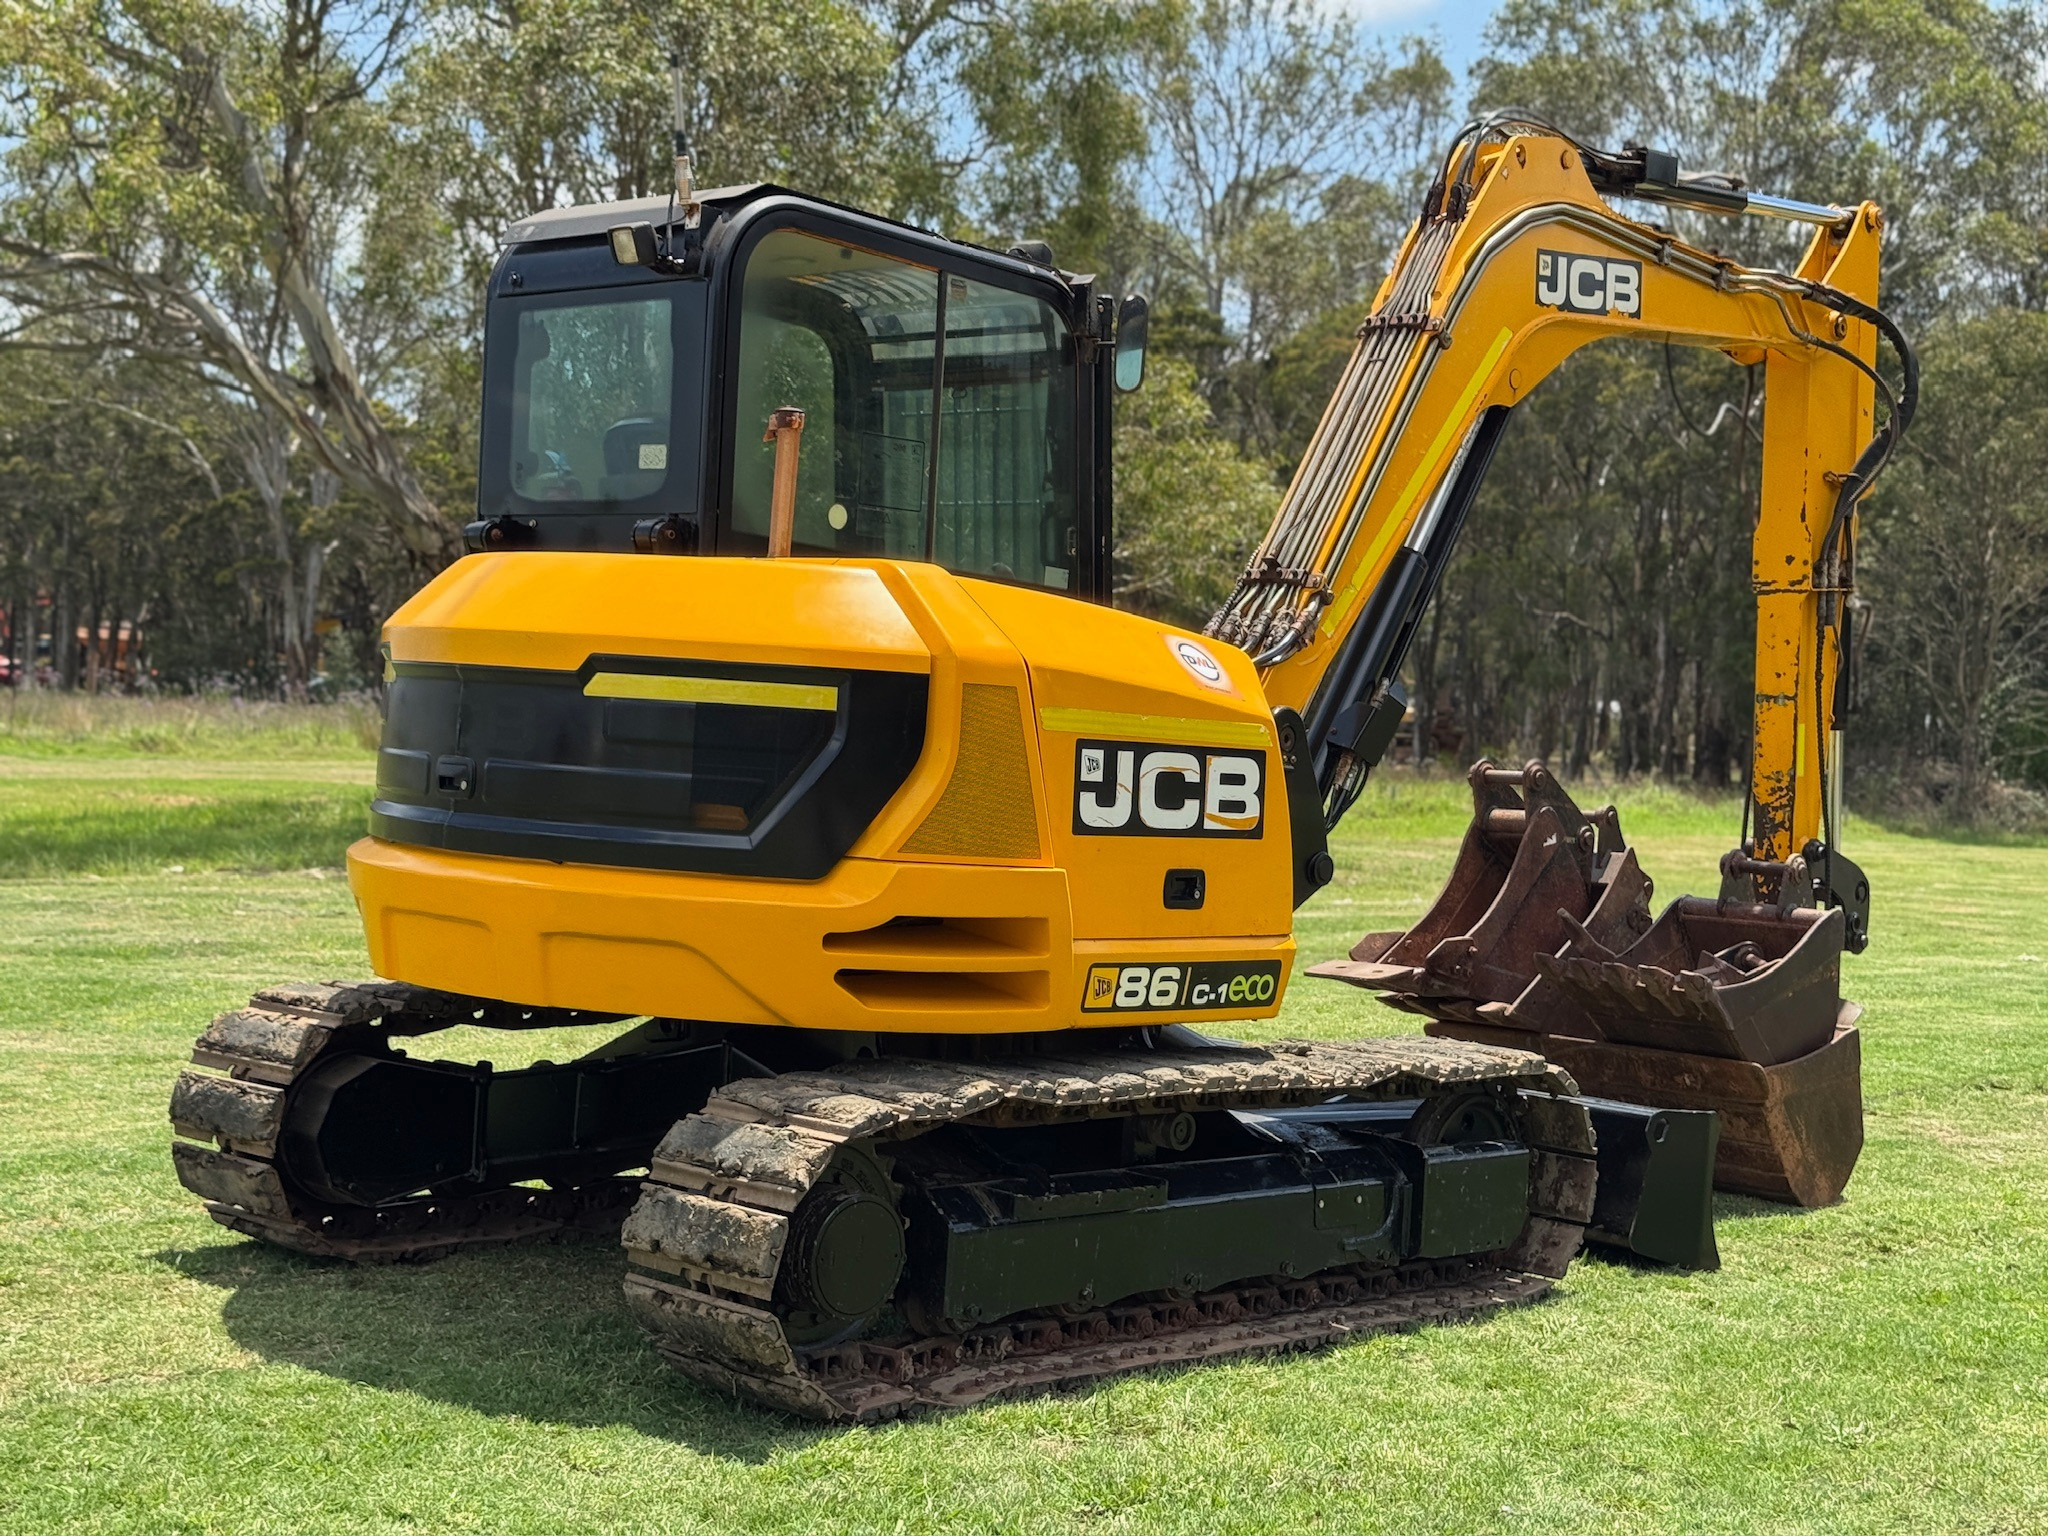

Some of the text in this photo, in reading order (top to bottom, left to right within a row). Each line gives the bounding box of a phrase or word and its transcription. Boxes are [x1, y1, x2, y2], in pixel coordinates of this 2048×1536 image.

[1538, 254, 1640, 313] JCB
[1079, 748, 1260, 831] JCB
[1095, 978, 1112, 997] JCB
[1115, 967, 1181, 1008] 86
